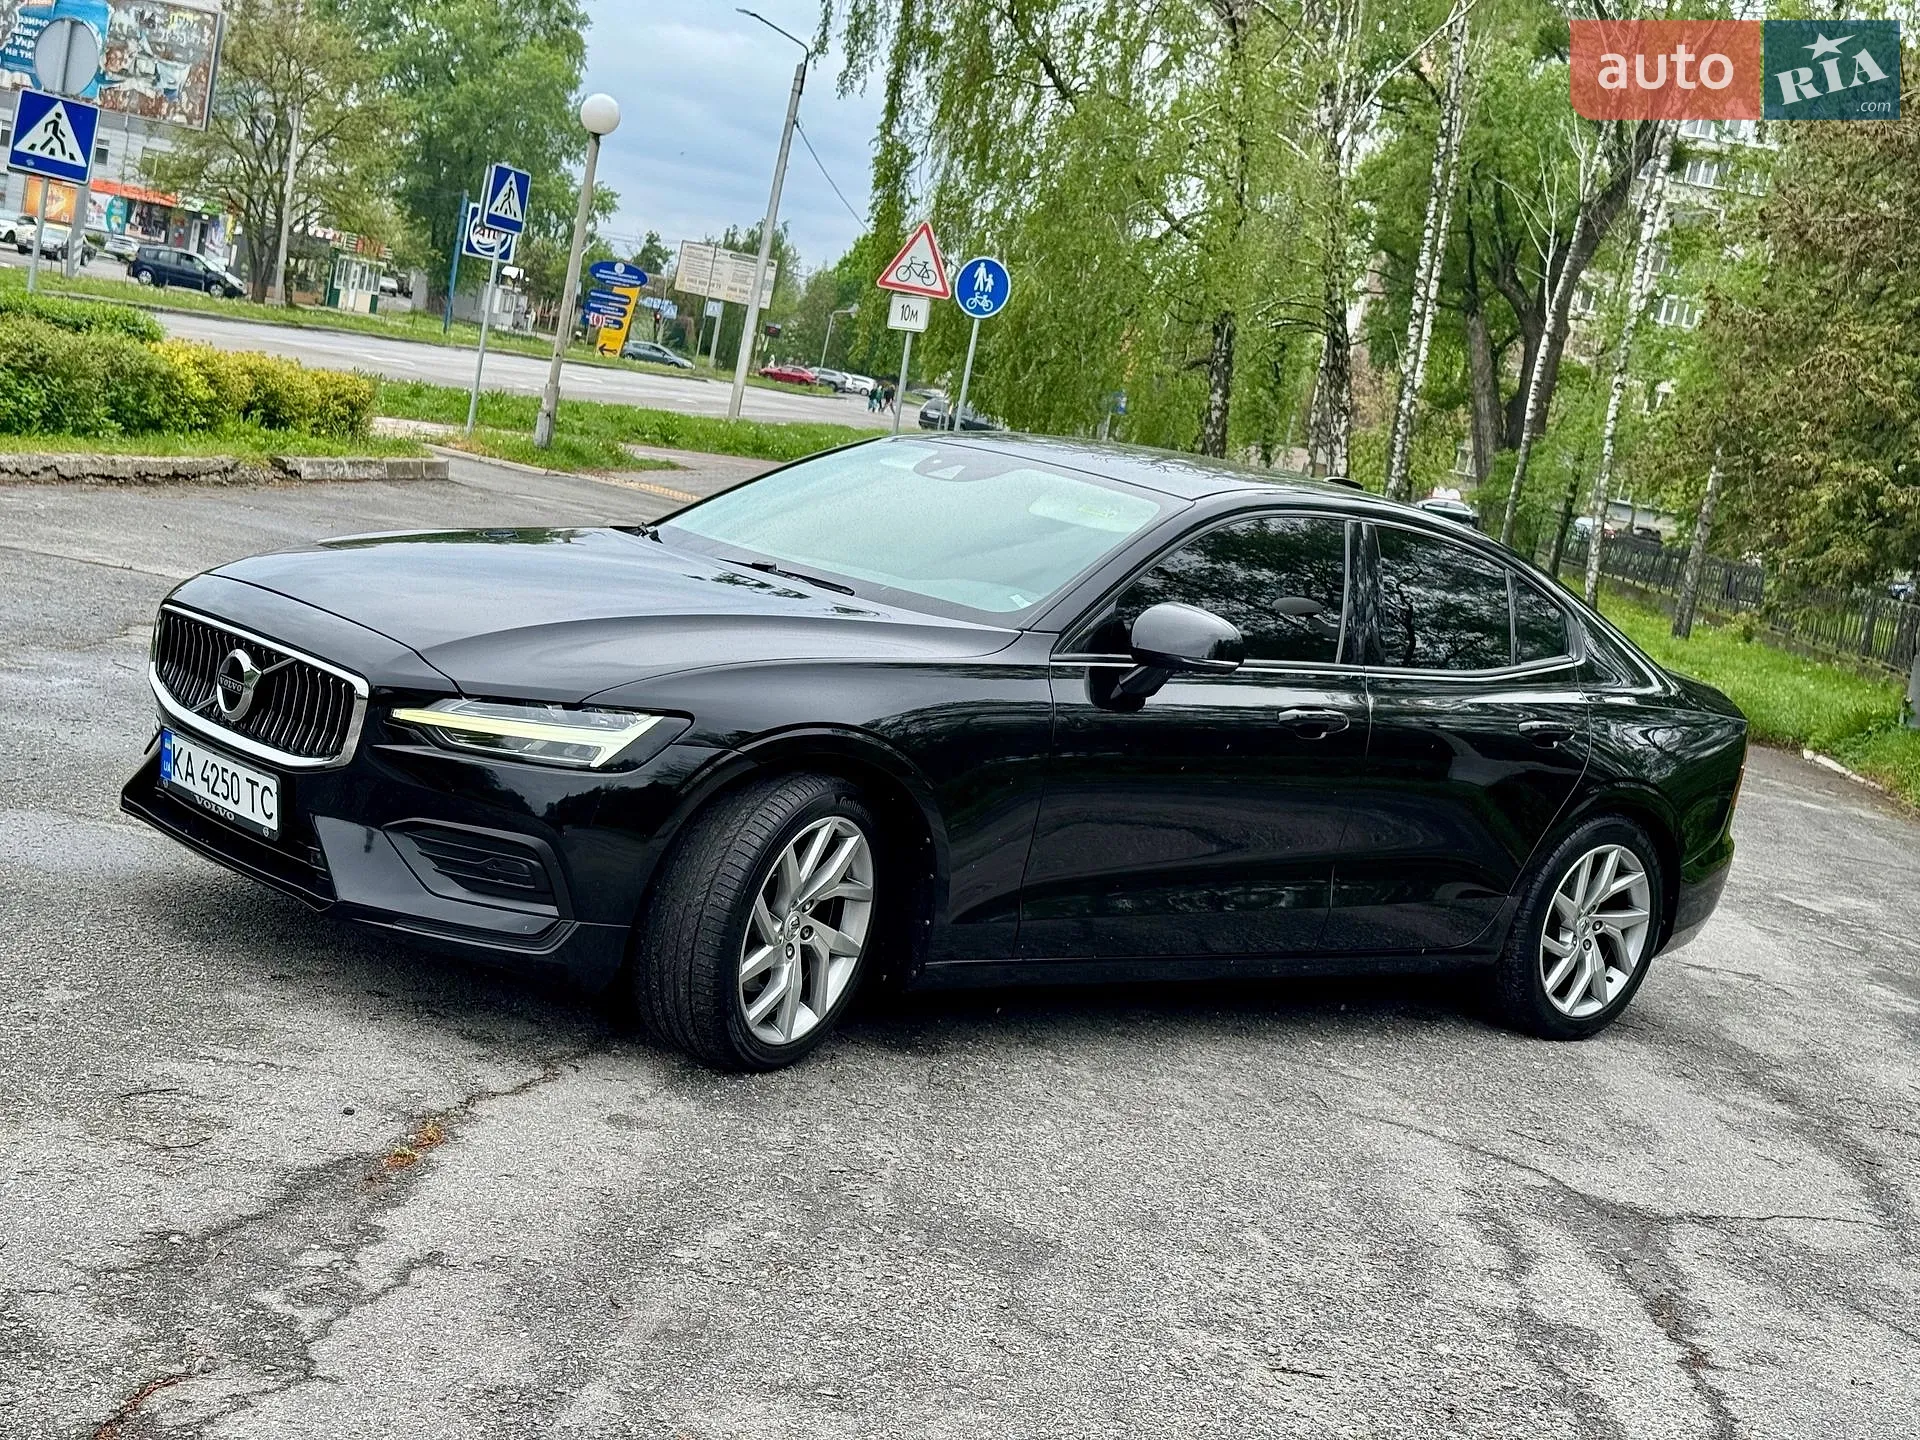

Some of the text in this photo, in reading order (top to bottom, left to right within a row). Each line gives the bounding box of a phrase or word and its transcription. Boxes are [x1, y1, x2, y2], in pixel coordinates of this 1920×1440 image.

[220, 676, 242, 692] VOLVO
[172, 743, 274, 820] KA 4250 TC
[193, 794, 235, 821] VOLVO
